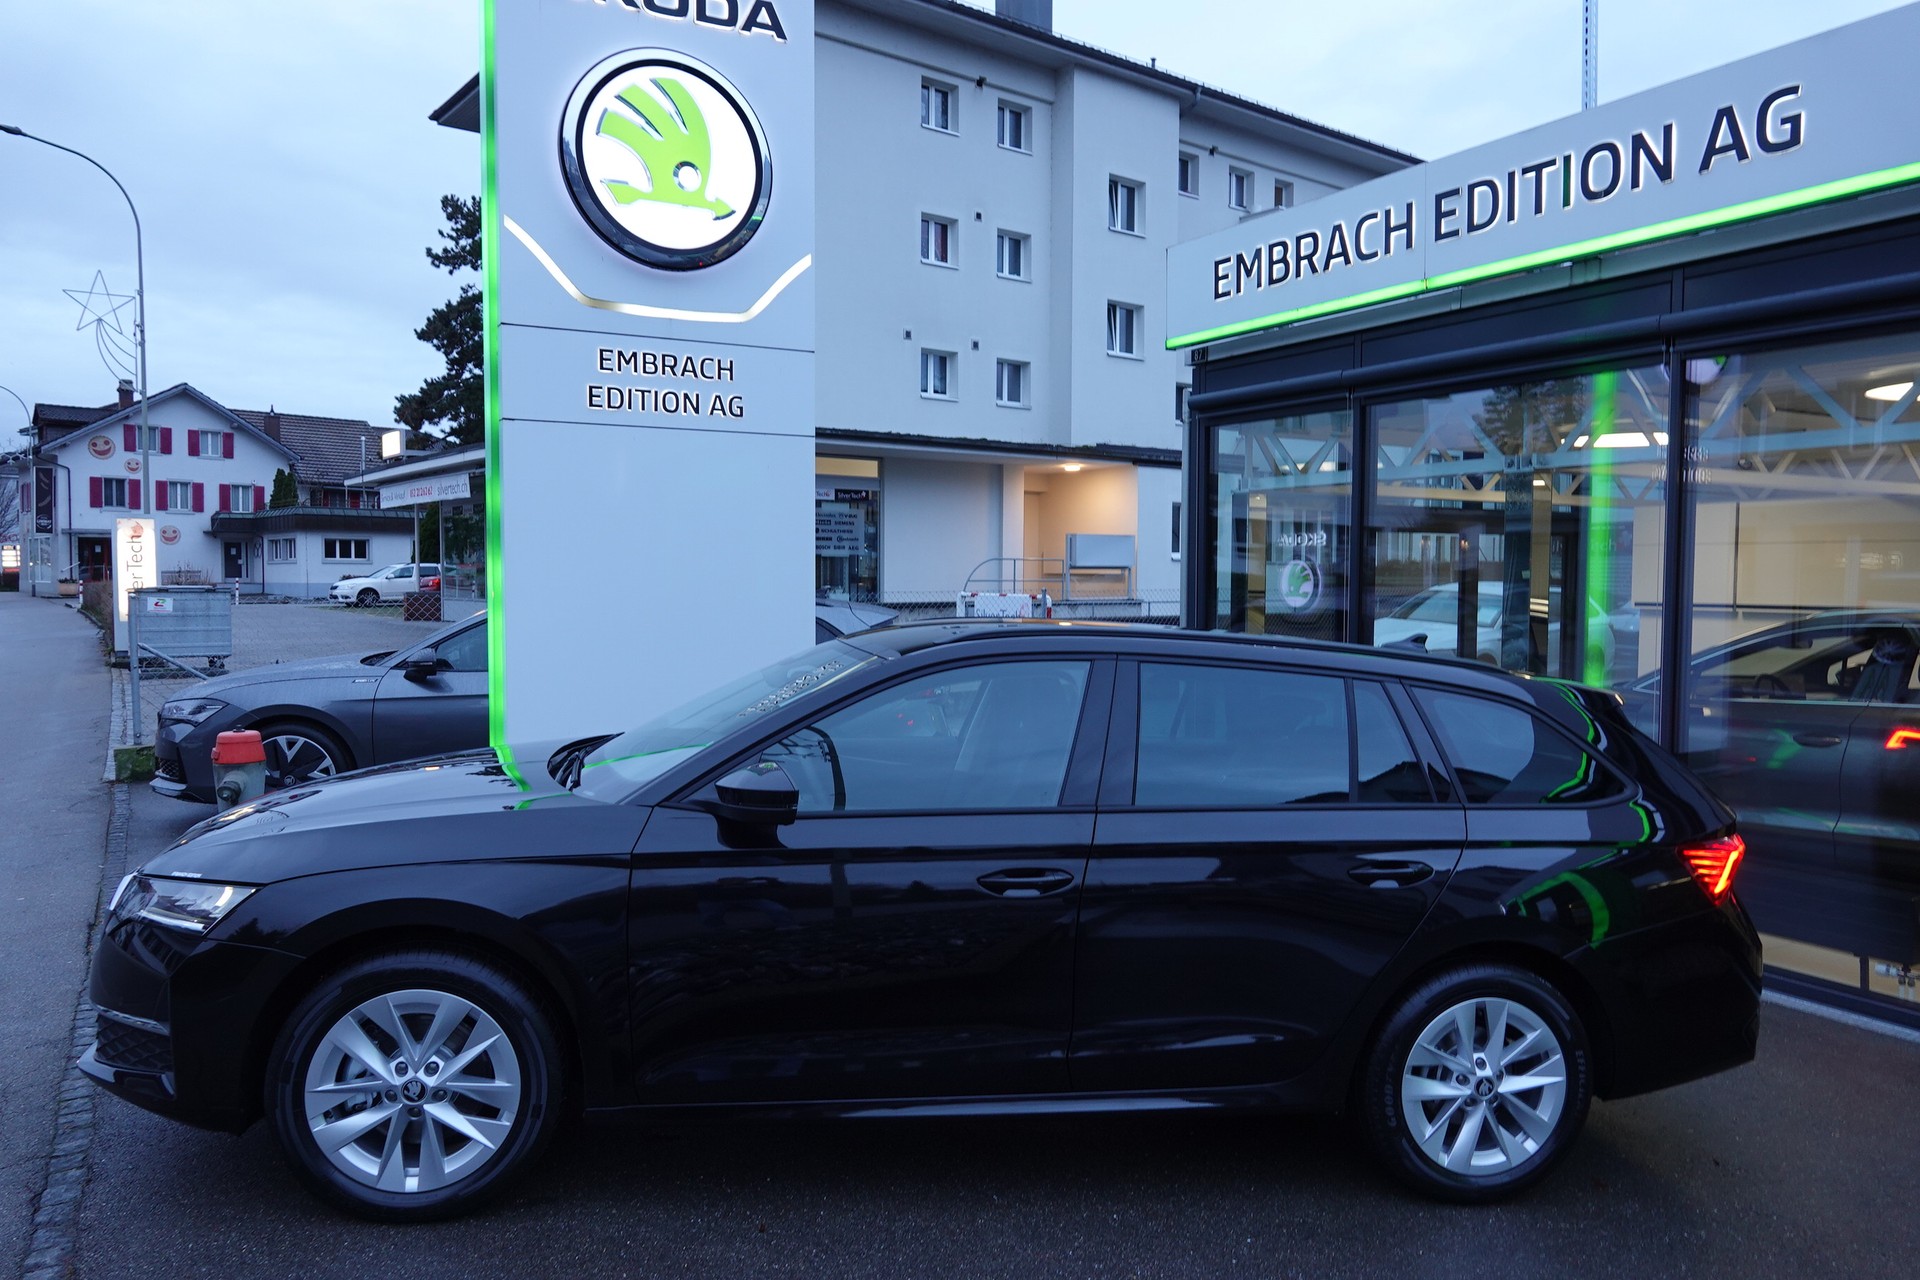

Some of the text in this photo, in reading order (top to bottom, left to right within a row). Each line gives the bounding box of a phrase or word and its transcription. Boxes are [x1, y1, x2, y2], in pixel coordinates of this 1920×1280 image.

[1213, 83, 1805, 301] EMBRACH EDITION AG
[599, 348, 734, 381] EMBRACH
[1194, 349, 1203, 361] 87
[588, 385, 744, 418] EDITION AG
